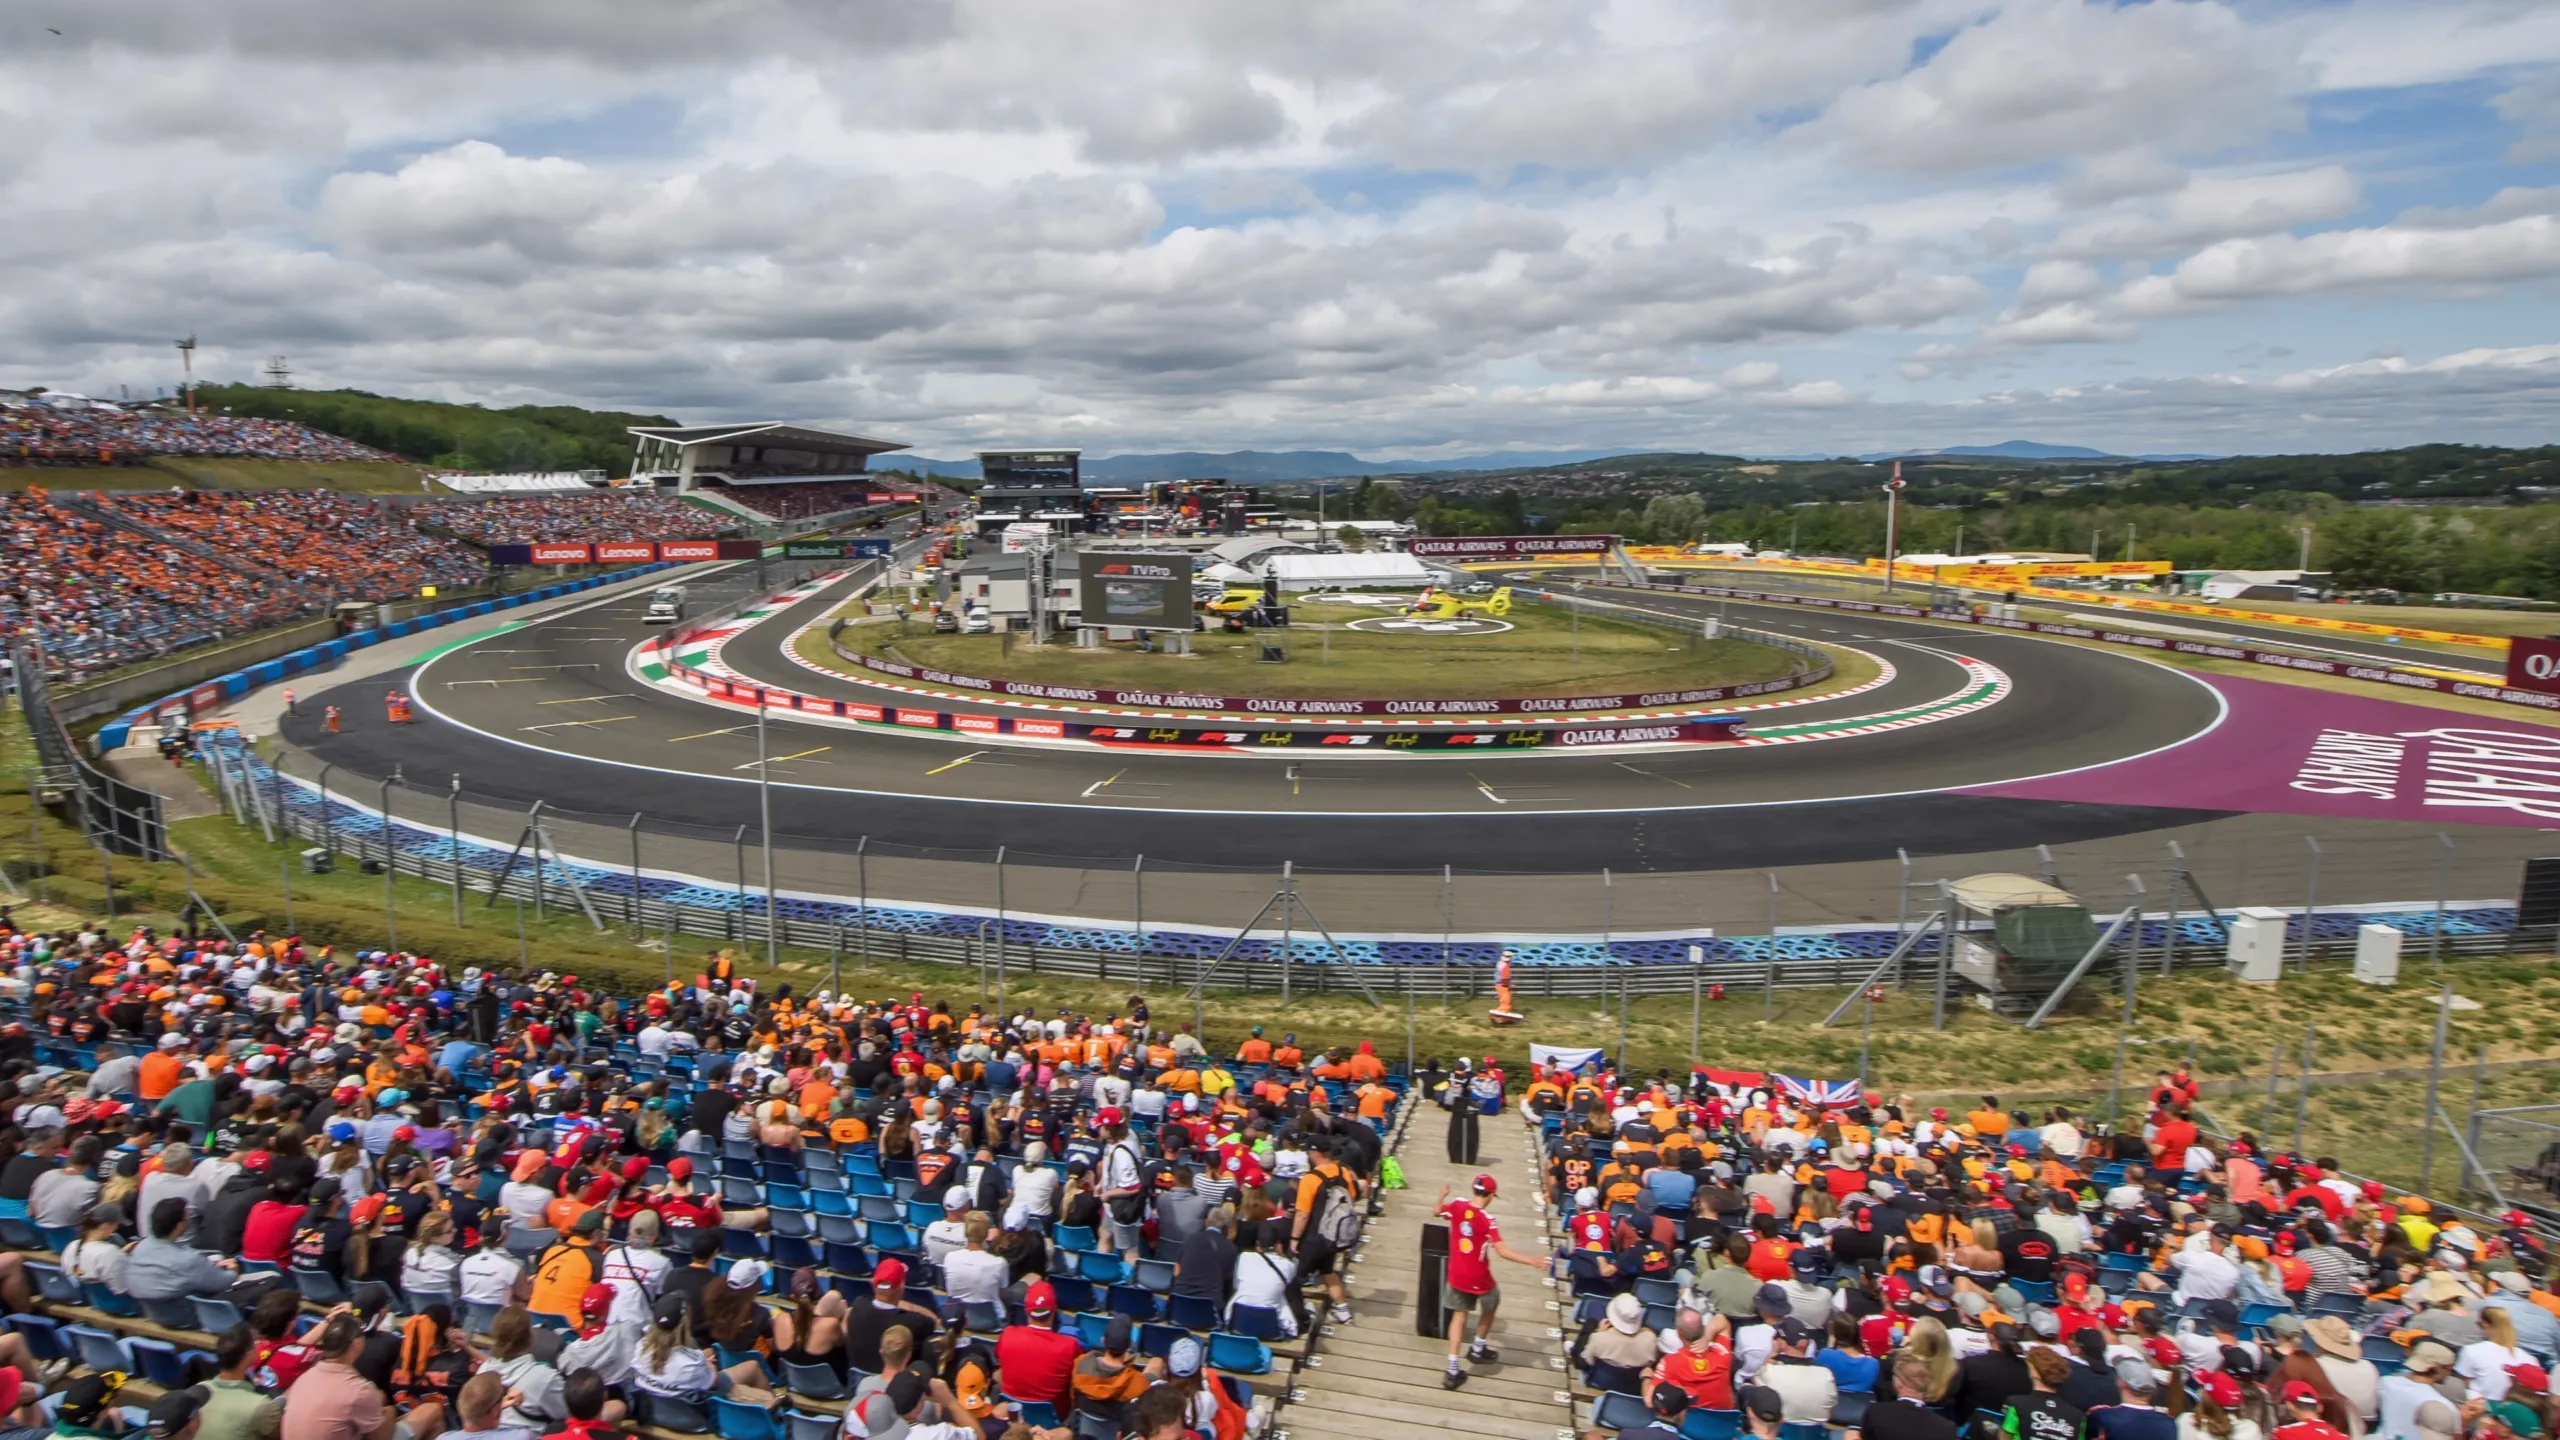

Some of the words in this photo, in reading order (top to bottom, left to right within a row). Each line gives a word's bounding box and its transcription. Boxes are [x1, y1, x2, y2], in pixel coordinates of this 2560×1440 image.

[663, 545, 714, 558] Lenovo
[1414, 541, 1455, 554] QATAR
[1457, 541, 1507, 552] AIRWAYS
[1514, 540, 1553, 552] QATAR
[1555, 539, 1606, 550] AIRWAYS
[535, 548, 586, 560] Lenovo
[599, 547, 651, 559] Lenovo
[1006, 682, 1044, 696] QATAR
[1045, 686, 1098, 701] AIRWAYS
[1640, 693, 1679, 706] QATAR
[1680, 688, 1723, 703] AIRWAYS
[1116, 692, 1162, 706] QATAR
[1164, 695, 1224, 709] AIRWAYS
[1246, 699, 1296, 712] QATAR
[1299, 701, 1363, 713] AIRWAYS
[1385, 700, 1436, 713] QATAR
[1437, 700, 1499, 712] AIRWAYS
[1520, 698, 1564, 712] QATAR
[1567, 696, 1623, 711] AIRWAYS
[847, 705, 880, 718] Lenovo
[898, 712, 935, 724] Lenovo
[955, 717, 995, 729] Lenovo
[1017, 722, 1060, 735] Lenovo
[1562, 730, 1617, 745] QATAR
[1619, 726, 1680, 742] AIRWAYS
[2288, 728, 2408, 800] AIRWAYS
[1564, 1159, 1591, 1175] OP
[1565, 1174, 1588, 1190] 81
[545, 1265, 560, 1284] 4
[2030, 1411, 2074, 1437] Stake
